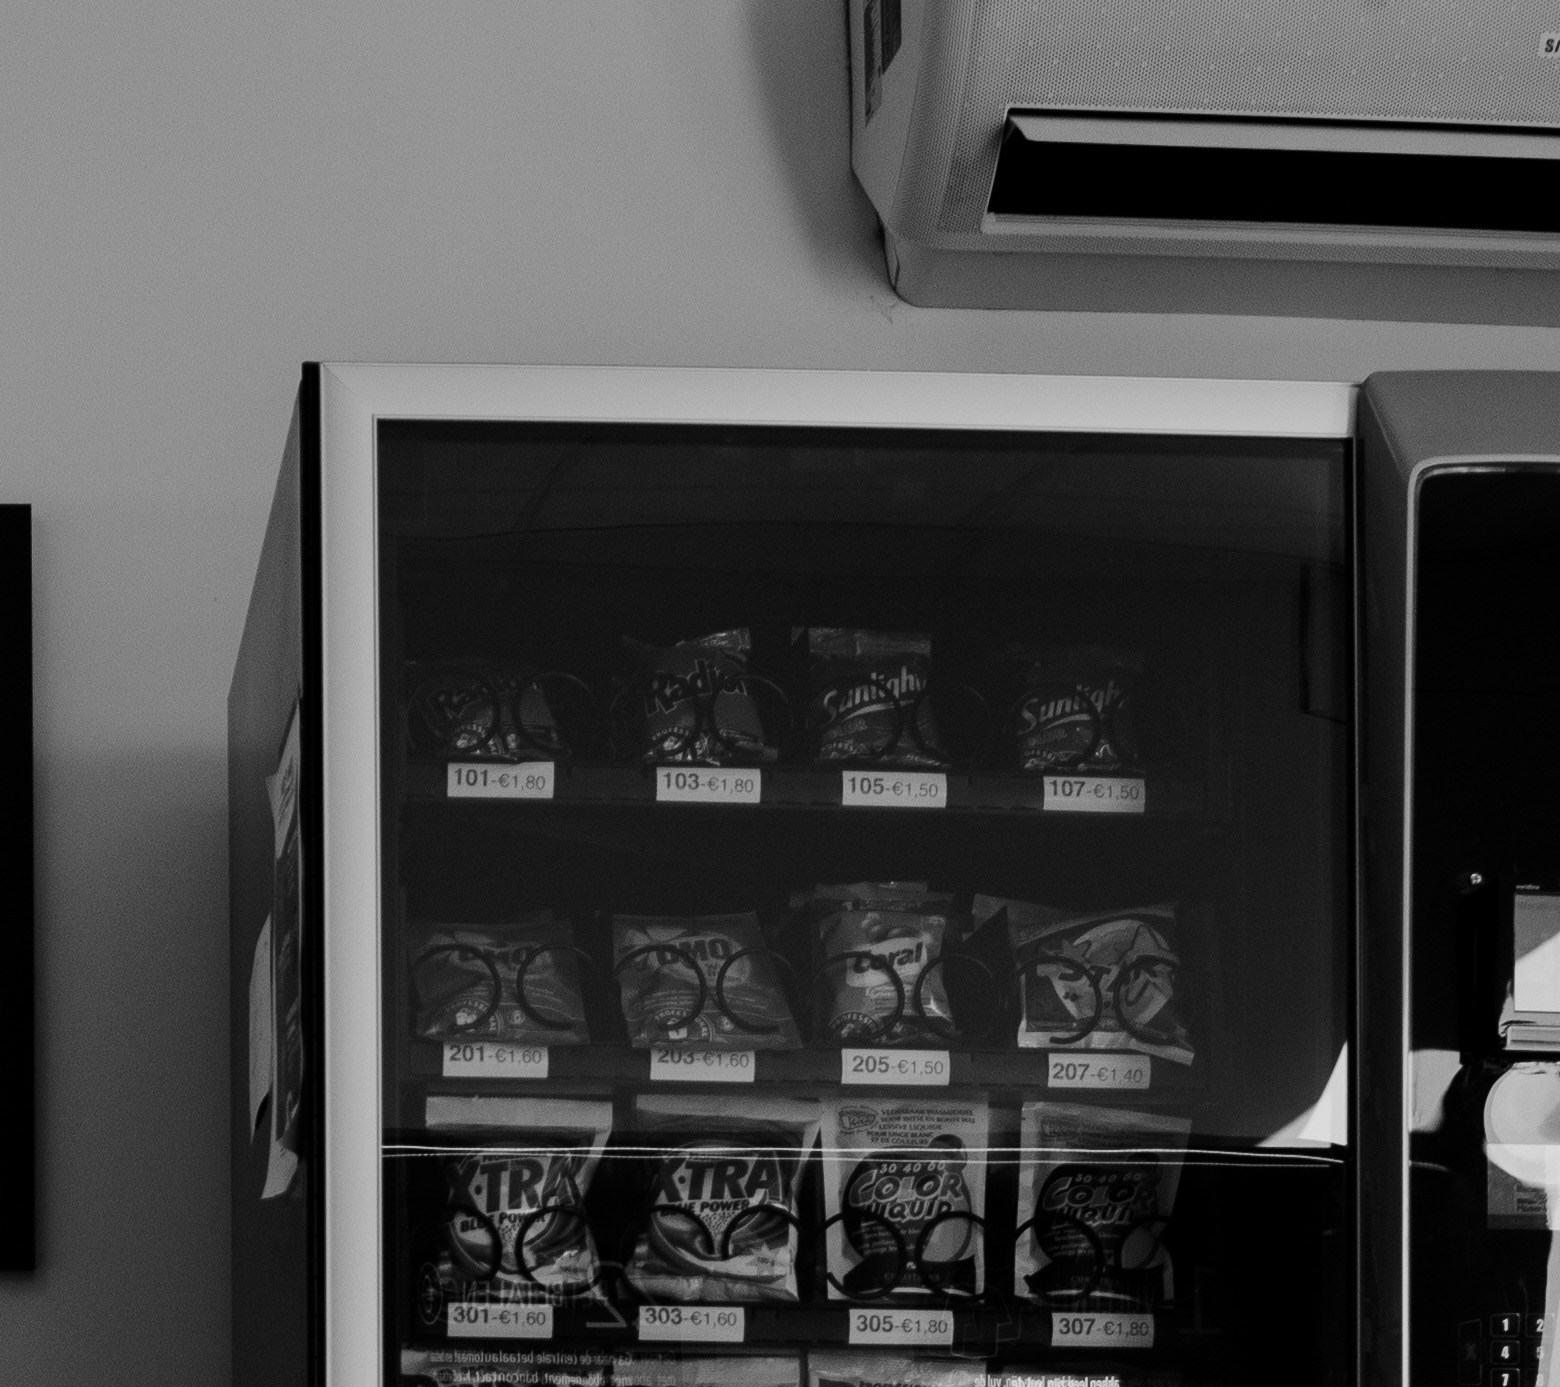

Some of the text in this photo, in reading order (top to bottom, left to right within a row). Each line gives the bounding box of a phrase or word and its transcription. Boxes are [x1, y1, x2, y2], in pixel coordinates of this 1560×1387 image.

[453, 768, 546, 791] 101-€1,80
[663, 772, 755, 794] 103-€1,80
[848, 777, 939, 799] 105-€1,50
[1049, 780, 1140, 801] 107-€1,50
[852, 1055, 945, 1077] 205-€1,50
[1052, 1063, 1144, 1084] 207-€1,40
[849, 1168, 965, 1207] COLOR
[699, 1199, 750, 1213] POWER
[453, 1306, 546, 1327] 301-€1,60
[645, 1307, 737, 1327] 303-€1,60
[856, 1315, 948, 1336] 305-€1,80
[1502, 1318, 1544, 1333] 1 2
[1058, 1318, 1150, 1337] 307-€1,80
[1501, 1345, 1510, 1359] 4
[1501, 1373, 1510, 1387] 7
